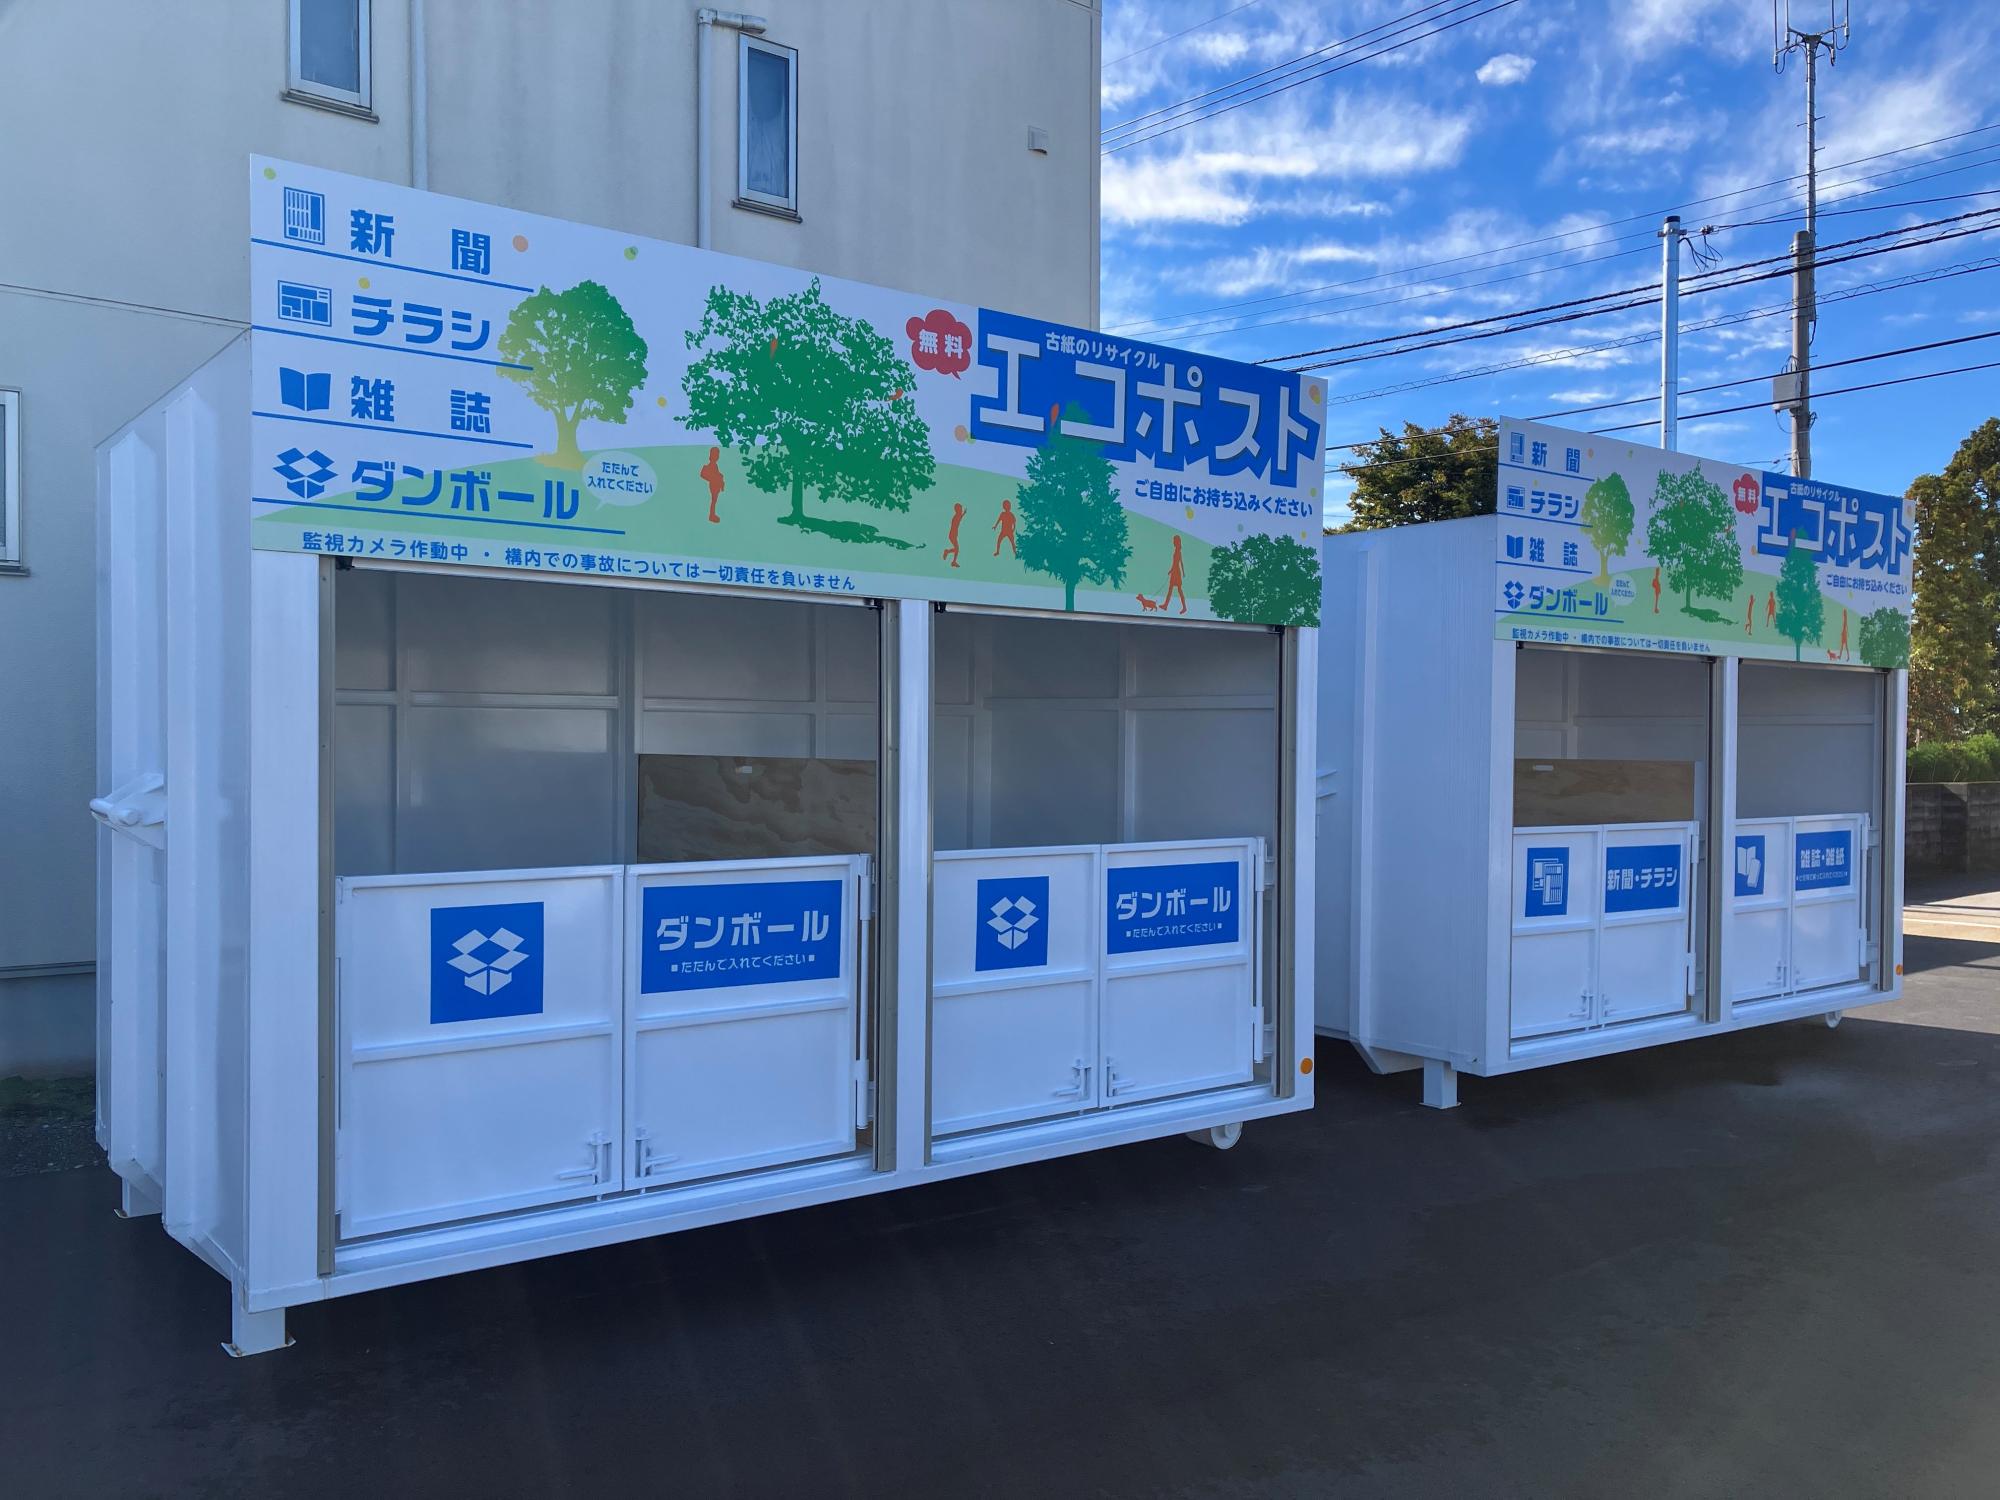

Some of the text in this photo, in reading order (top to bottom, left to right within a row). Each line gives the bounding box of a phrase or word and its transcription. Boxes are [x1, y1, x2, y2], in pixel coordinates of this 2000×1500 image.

[350, 208, 490, 275] 新聞
[351, 294, 491, 351] チラシ
[918, 328, 964, 360] 無料
[1045, 331, 1161, 370] 古紙のリサイクル
[350, 375, 491, 434] 雑誌
[979, 332, 1308, 471] エコポスト
[1531, 441, 1581, 474] 新聞
[351, 459, 580, 520] ダンボール
[587, 475, 653, 494] 入れてください
[1134, 479, 1313, 518] ご自由にお持ち込みください
[1530, 490, 1579, 519] チラシ
[1761, 486, 1906, 565] エコポスト
[1529, 585, 1609, 616] ダンボール
[1607, 867, 1678, 891] 新聞・チラシ
[1116, 887, 1231, 920] ダンボール
[657, 911, 830, 951] ダンボール
